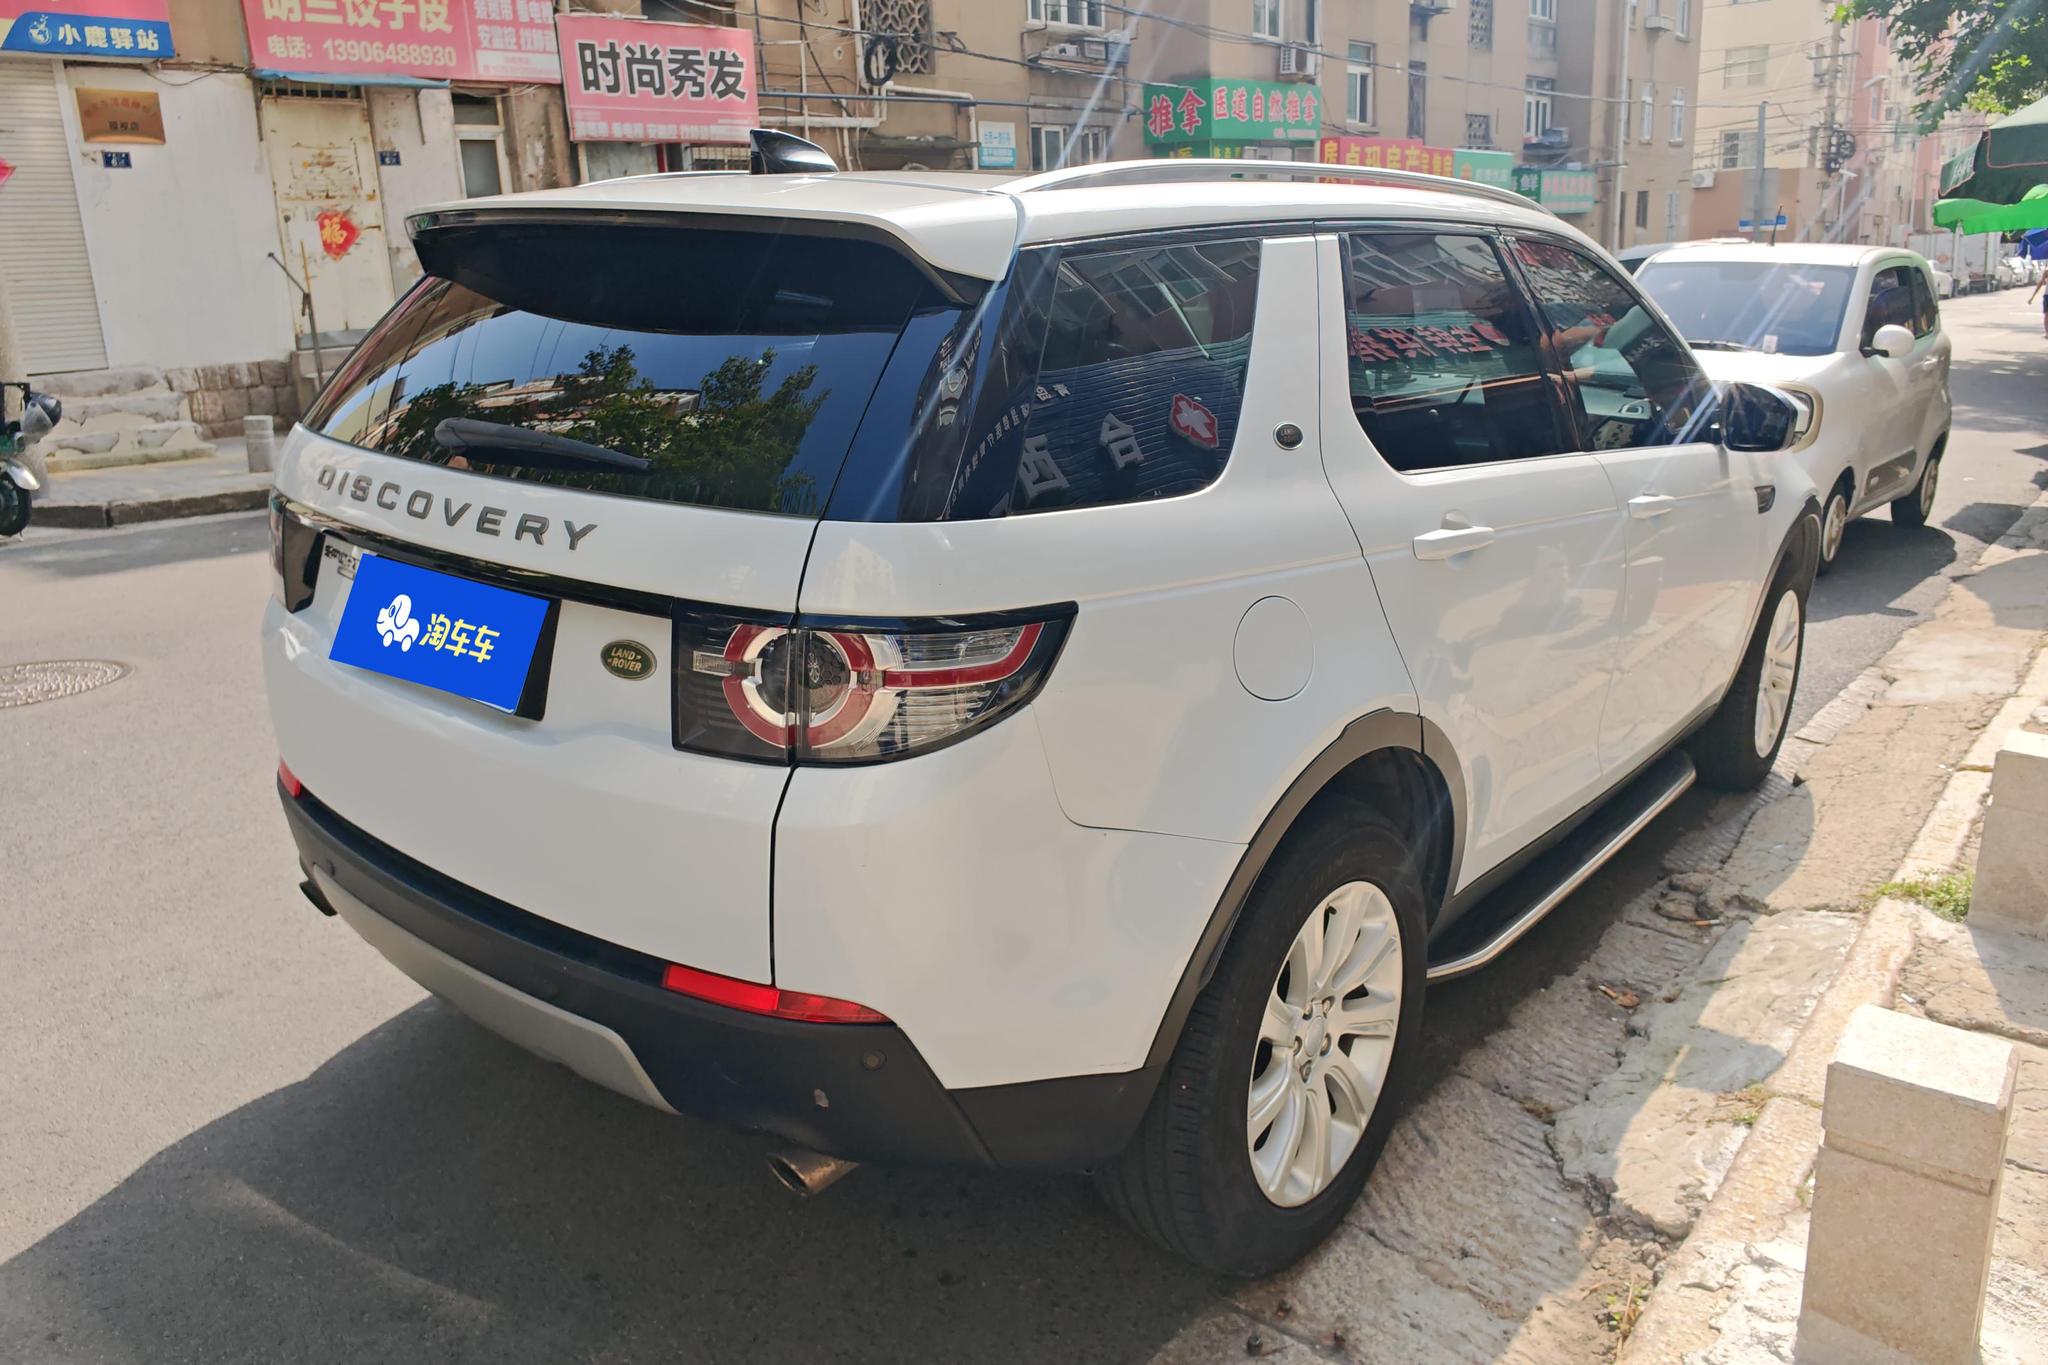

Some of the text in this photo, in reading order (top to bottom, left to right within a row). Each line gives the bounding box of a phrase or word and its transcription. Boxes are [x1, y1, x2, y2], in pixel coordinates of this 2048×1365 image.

[323, 37, 457, 67] 13906488930
[576, 39, 747, 101] 时尚秀发
[1149, 88, 1206, 138] 推拿
[1213, 86, 1318, 126] 医道自然推拿
[317, 464, 598, 551] DISCOVERY
[611, 647, 637, 660] LAND
[611, 657, 642, 672] ROVER
